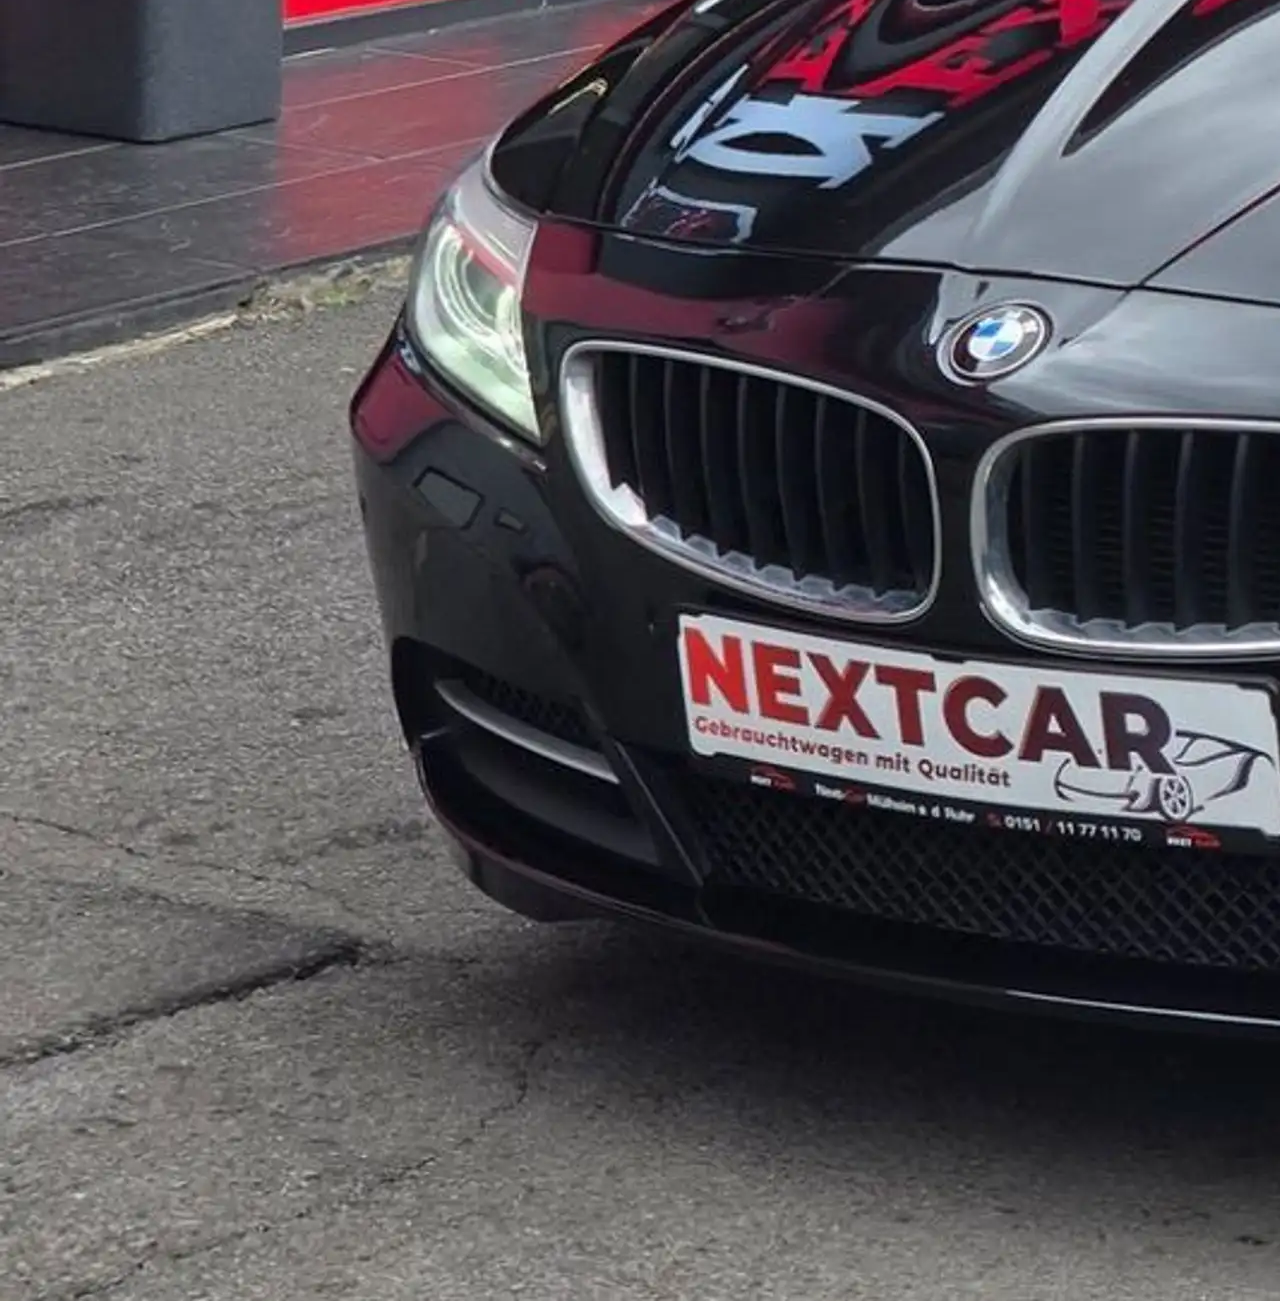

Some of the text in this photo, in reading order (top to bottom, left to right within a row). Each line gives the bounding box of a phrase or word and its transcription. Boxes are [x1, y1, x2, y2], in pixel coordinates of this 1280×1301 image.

[684, 626, 1178, 775] NEXTCAR
[694, 716, 1011, 788] Gebrauchtwagen mit Qualität
[1004, 816, 1041, 832] 0151
[1056, 821, 1076, 835] 11
[1078, 823, 1097, 837] 77
[1100, 825, 1119, 840] 11
[1121, 827, 1143, 842] 70
